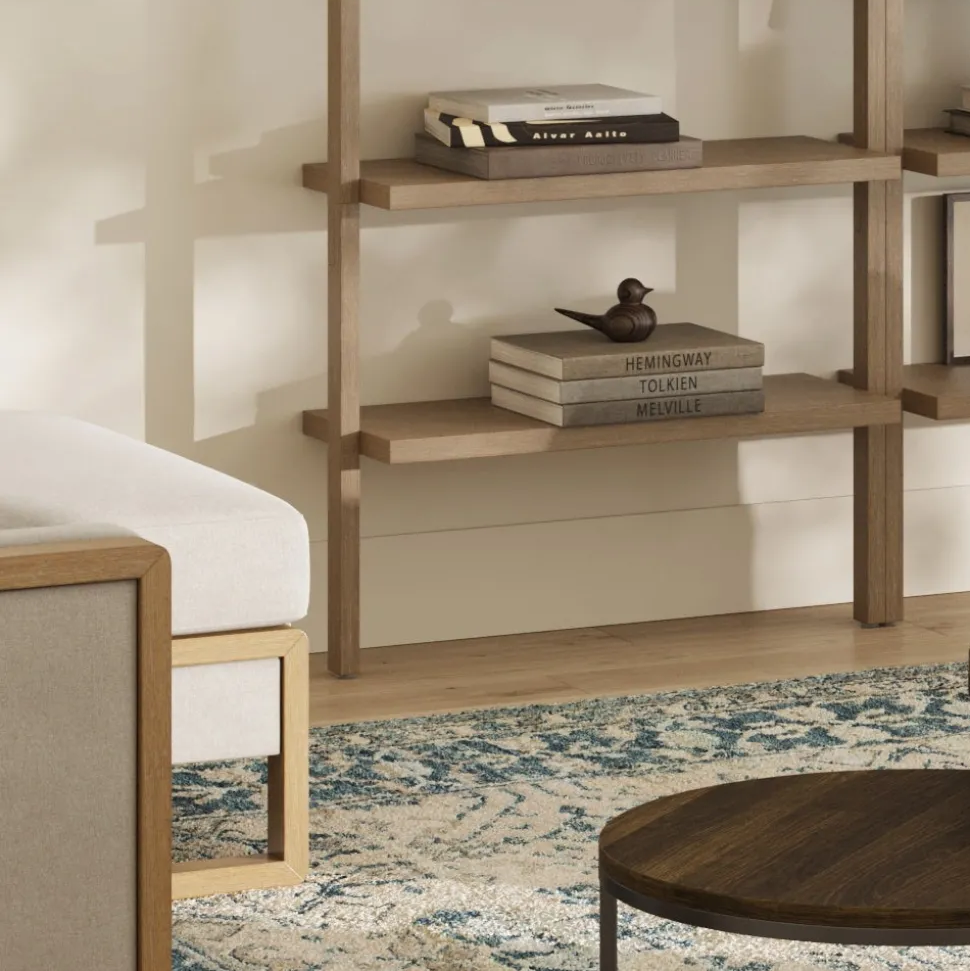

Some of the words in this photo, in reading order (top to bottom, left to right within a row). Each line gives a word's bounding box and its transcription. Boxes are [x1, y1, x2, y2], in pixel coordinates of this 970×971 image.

[533, 131, 576, 139] Alvar
[584, 129, 627, 138] Aalto
[626, 351, 712, 371] HEMINGWAY
[640, 376, 698, 393] TOLKIEN
[636, 398, 702, 418] MELVILLE
